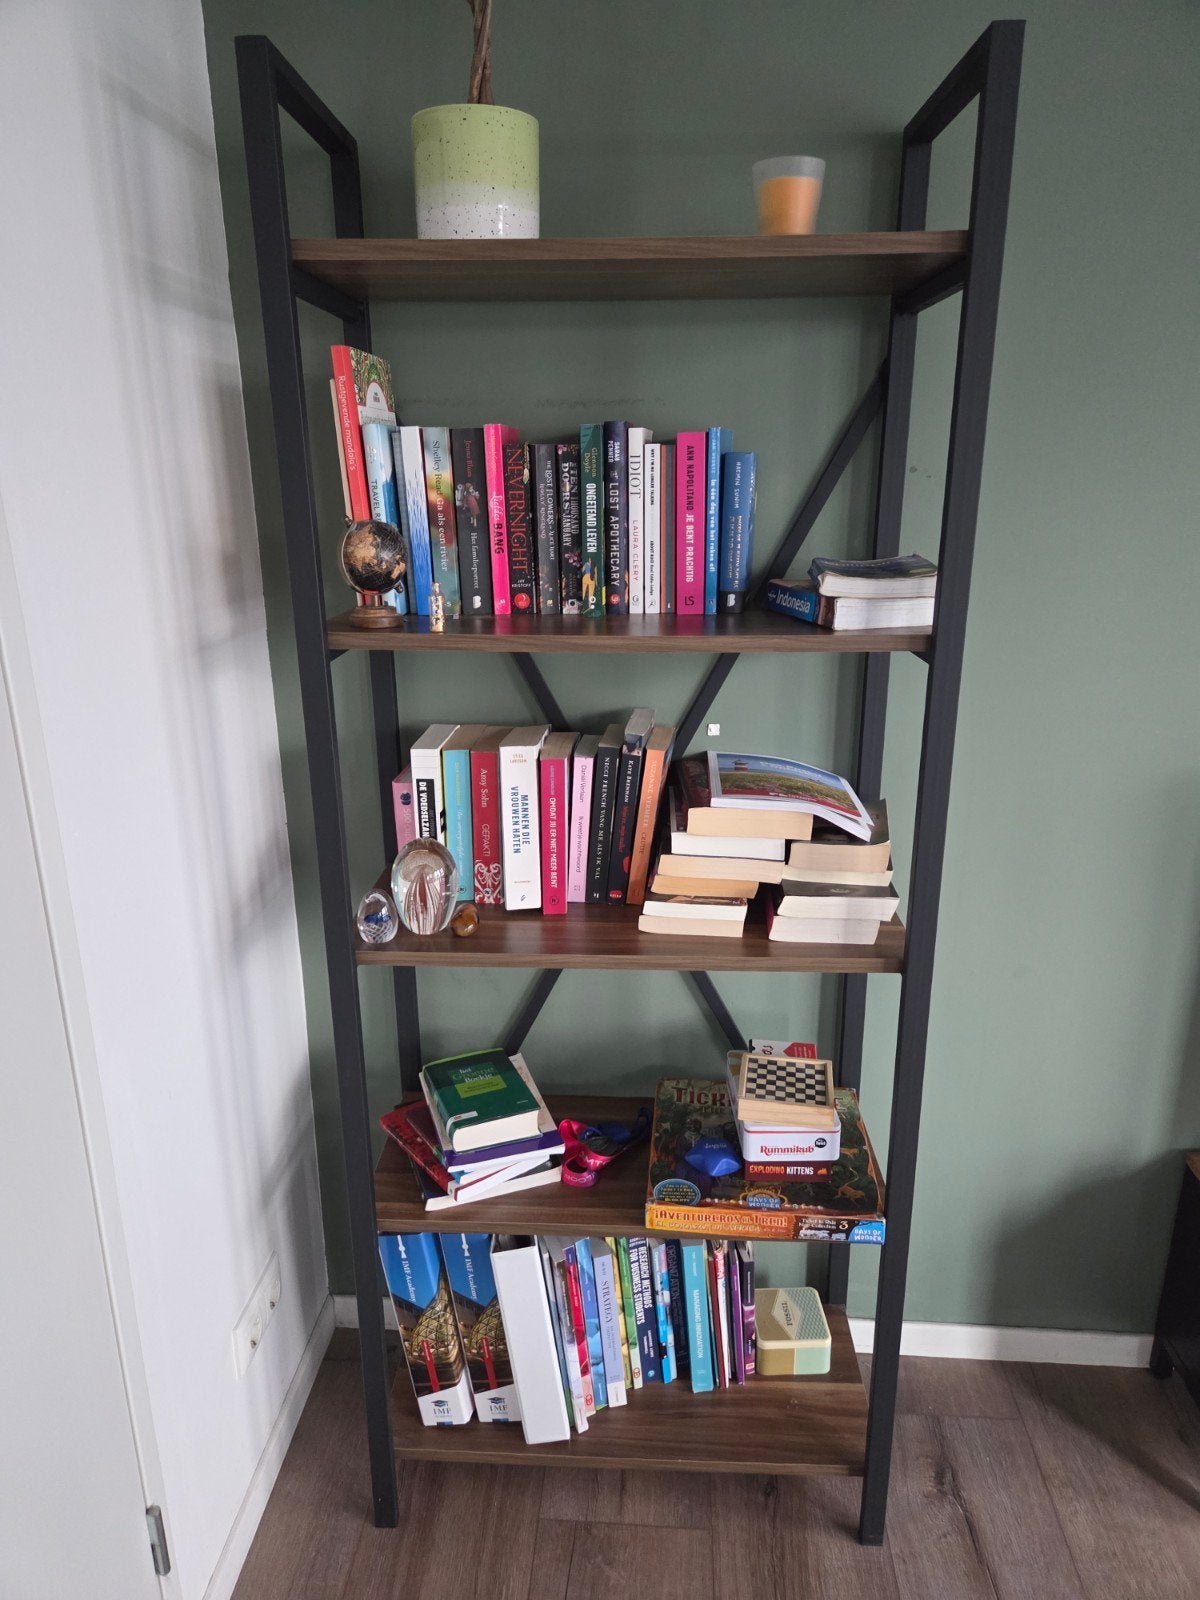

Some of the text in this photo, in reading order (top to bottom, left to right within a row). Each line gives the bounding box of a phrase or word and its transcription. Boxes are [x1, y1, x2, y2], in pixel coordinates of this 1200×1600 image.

[337, 375, 357, 471] Rustgevende mandala's
[584, 451, 592, 473] Doyle
[629, 453, 642, 498] IDIOT
[545, 469, 554, 488] LOST
[570, 469, 579, 493] TEN
[370, 480, 381, 510] TRAVEL
[431, 440, 450, 572] Shelley Read Ga als een rivier
[507, 448, 529, 574] NEVERNIGHT
[547, 488, 556, 525] FLOWERS
[609, 482, 620, 510] LOST
[562, 513, 571, 547] JANUARY
[586, 482, 598, 552] ONGETEMD LEVEN
[685, 445, 695, 583] ANN NAPOLITANO JE BENT PRACHTIG
[494, 522, 505, 554] BANG
[609, 514, 621, 585] APOTHECARY
[470, 530, 481, 591] Het familieportret
[776, 589, 811, 614] Indonesia
[603, 757, 611, 778] NICCI
[624, 760, 635, 803] KATE BRENNAN
[479, 768, 489, 808] Amy Sohn
[600, 779, 609, 808] FRENCH
[419, 781, 430, 838] DE VOEDSELZAN
[510, 786, 522, 854] VROUWEN HATEN
[521, 794, 531, 845] MANNEN DIE
[549, 797, 557, 820] OMDAT
[481, 823, 491, 857] GEPAKT!
[549, 828, 557, 838] ER
[597, 830, 604, 841] ME
[550, 853, 558, 871] MEER
[596, 857, 603, 865] IK
[550, 871, 558, 888] BENT
[760, 1144, 815, 1156] Rummikub
[749, 1165, 814, 1175] EXPLODING KITTENS
[839, 1220, 849, 1230] 3
[629, 1249, 638, 1262] FOR
[638, 1246, 648, 1279] RESEARCH
[402, 1260, 416, 1304] IMF Academy
[464, 1258, 478, 1301] IMF Academy
[630, 1262, 642, 1293] BUSINESS
[666, 1245, 680, 1300] ORGANIZATION
[602, 1280, 613, 1324] STRATEGY
[633, 1293, 645, 1325] STUDENTS
[642, 1279, 653, 1309] METHODS
[693, 1289, 704, 1359] MANAGING INNOVATION
[434, 1407, 451, 1415] IMF
[490, 1404, 508, 1412] IMF
